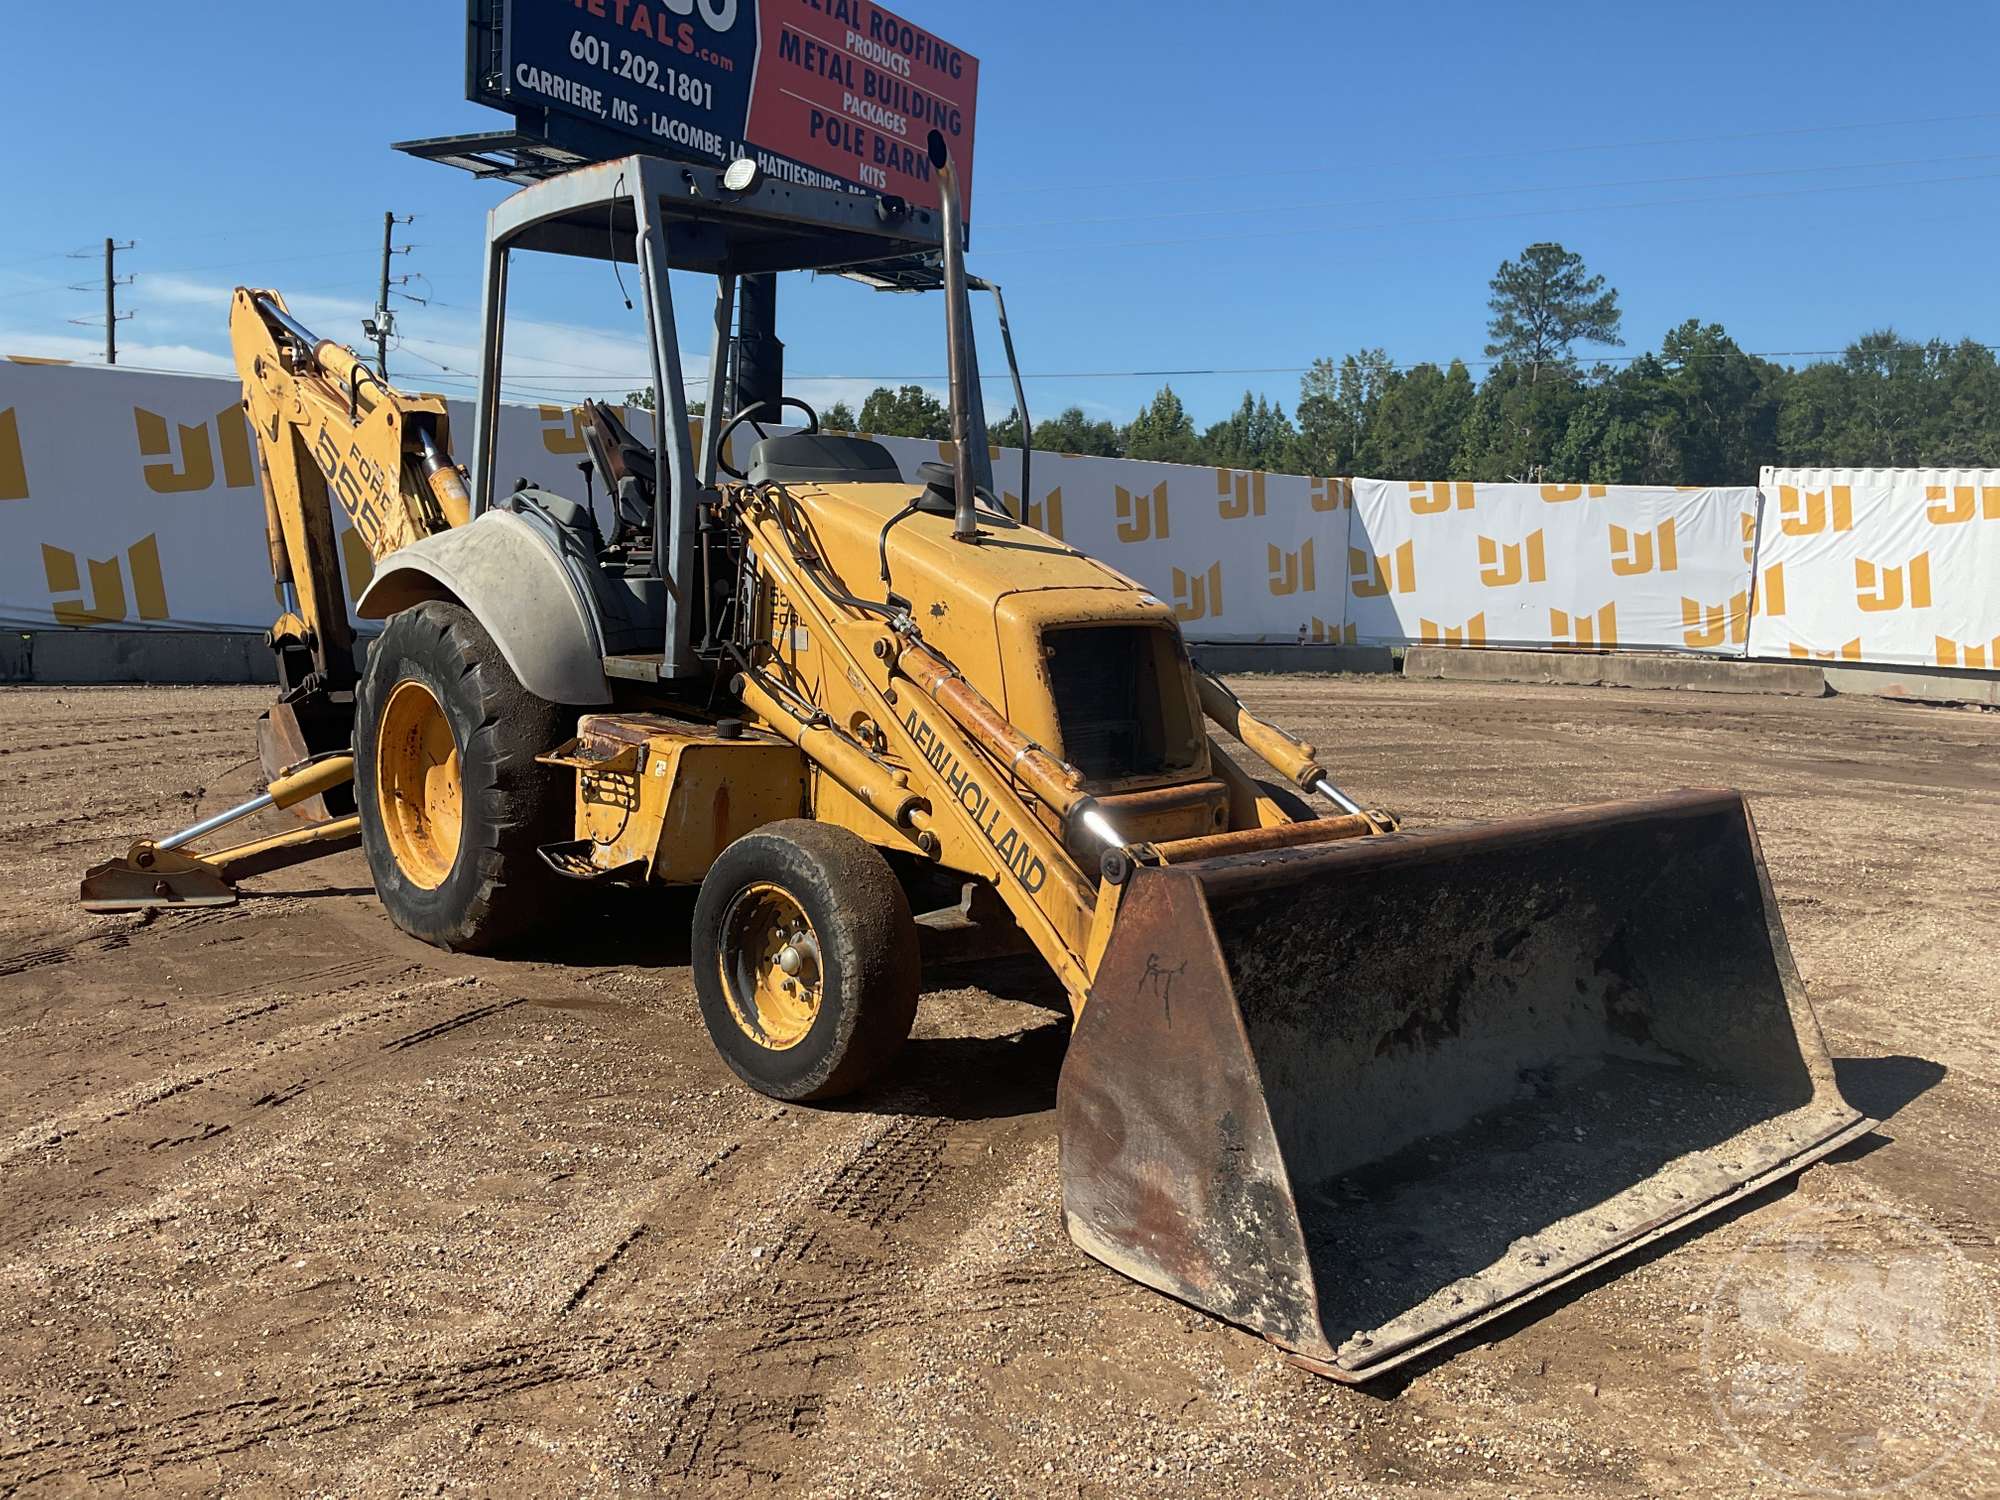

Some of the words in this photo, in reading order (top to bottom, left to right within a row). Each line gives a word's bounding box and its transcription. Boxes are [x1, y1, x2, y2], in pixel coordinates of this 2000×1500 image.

[570, 30, 712, 110] 601.202.1801
[574, 0, 734, 72] ETALS.com
[846, 31, 911, 77] PRODUCTS
[870, 11, 962, 79] ROOFING
[516, 63, 607, 119] CARRIERE,
[611, 98, 639, 126] MS
[652, 112, 727, 160] LACOMBE,
[729, 140, 746, 162] LA
[779, 30, 854, 89] METAL
[864, 68, 961, 136] BUILDING
[843, 93, 907, 135] PACKAGES
[810, 109, 864, 157] POLE
[874, 137, 930, 181] BARN
[859, 163, 887, 189] KITS
[316, 427, 382, 547] 555
[904, 709, 952, 774] NEW
[946, 760, 1047, 894] HOLLAND
